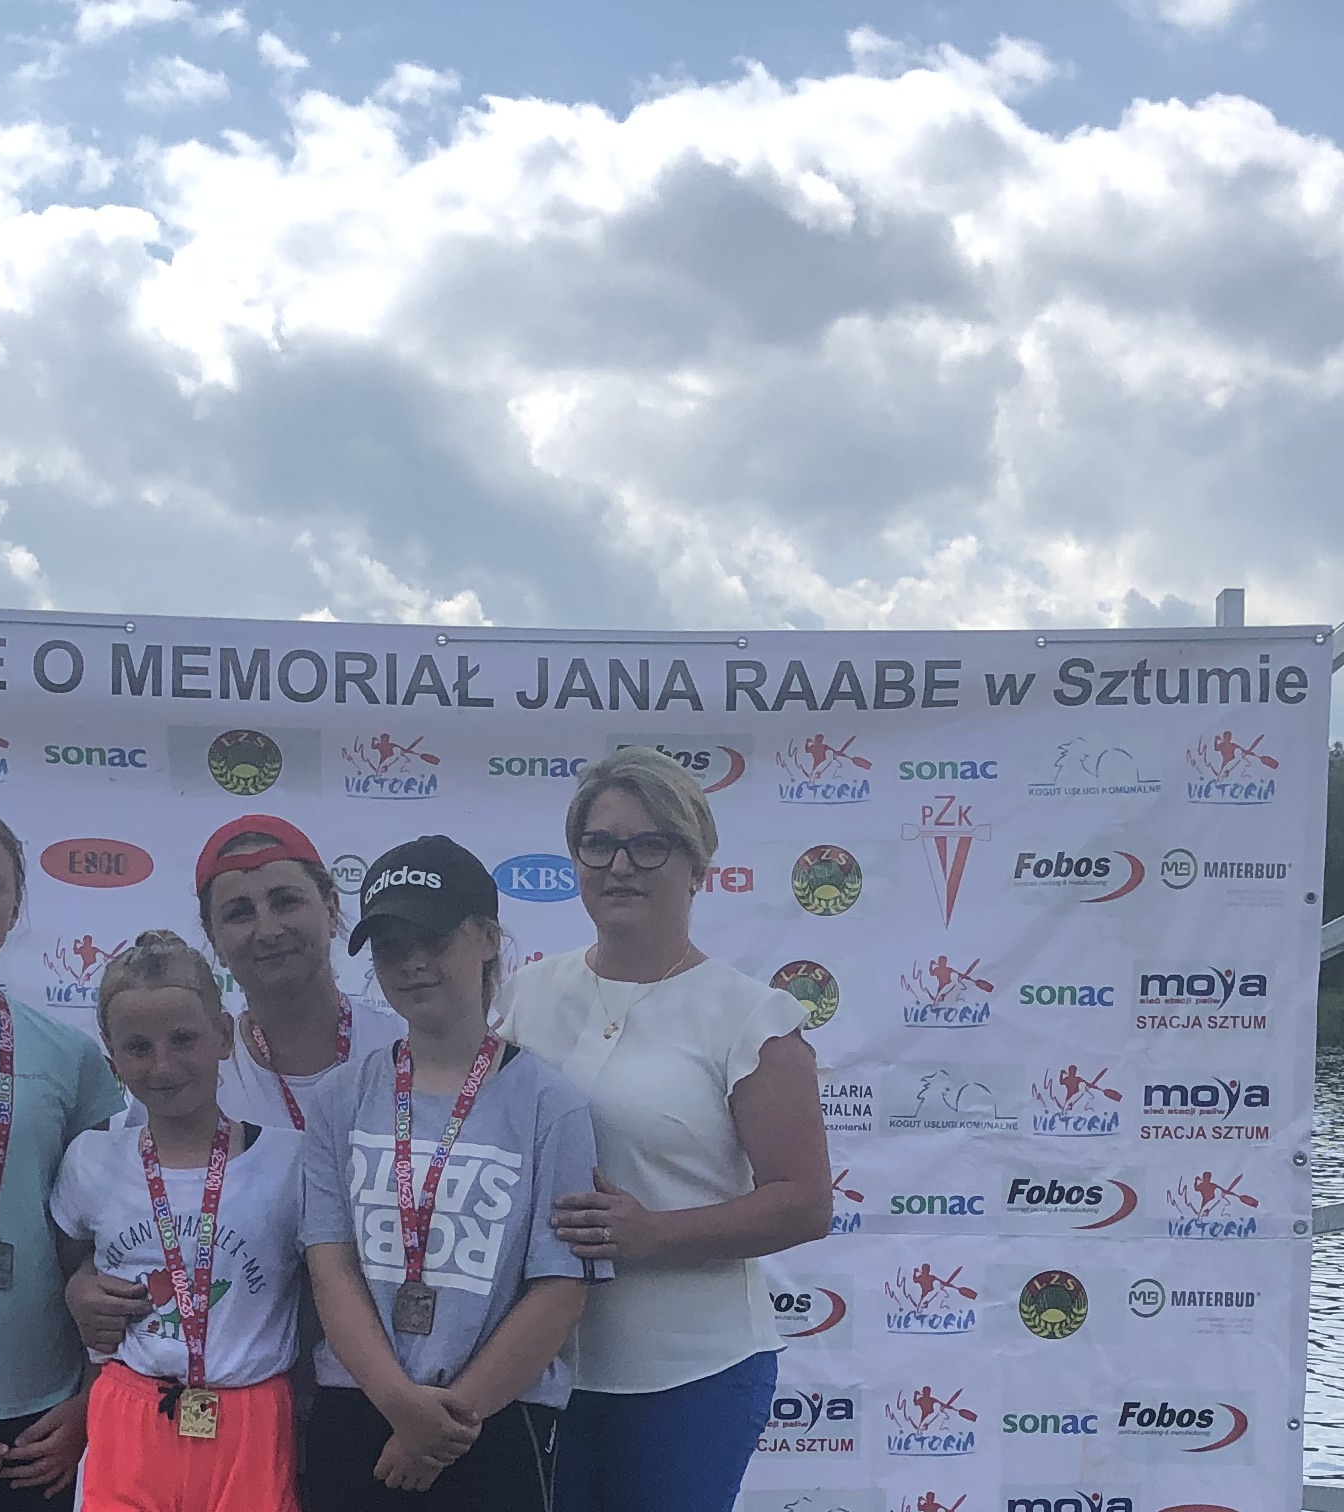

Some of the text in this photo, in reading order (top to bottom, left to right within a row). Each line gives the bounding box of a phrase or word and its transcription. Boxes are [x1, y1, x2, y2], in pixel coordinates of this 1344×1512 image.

[33, 639, 85, 694] O
[111, 642, 495, 709] MEMORIAŁ
[515, 656, 705, 712] JANA
[724, 659, 962, 712] RAABE
[984, 672, 1037, 706] w
[1053, 653, 1309, 706] Sztumie
[44, 743, 148, 770] sonac
[899, 759, 998, 781] sonac
[1028, 788, 1061, 797] KOGUT
[1101, 784, 1162, 796] KOMUNALNE
[921, 795, 974, 827] PZK
[1013, 851, 1112, 879] Fobos
[365, 866, 442, 904] adidas
[510, 866, 576, 892] KBS
[1019, 984, 1115, 1007] sonac
[1140, 965, 1267, 1011] moya
[1136, 1015, 1267, 1030] STACJA SZTUM
[1144, 1076, 1270, 1121] moya
[889, 1120, 923, 1129] KOGUT
[959, 1120, 1019, 1131] KOMUNALNE
[1140, 1126, 1269, 1140] STACJA SZTUM
[890, 1194, 984, 1215] sonac
[1007, 1178, 1103, 1205] Fobos
[119, 1219, 153, 1251] CAN
[1171, 1290, 1256, 1308] MATERBUD
[773, 1389, 854, 1434] oya
[1002, 1413, 1098, 1435] sonac
[1118, 1401, 1215, 1429] Fobos
[795, 1438, 854, 1452] SZTUM
